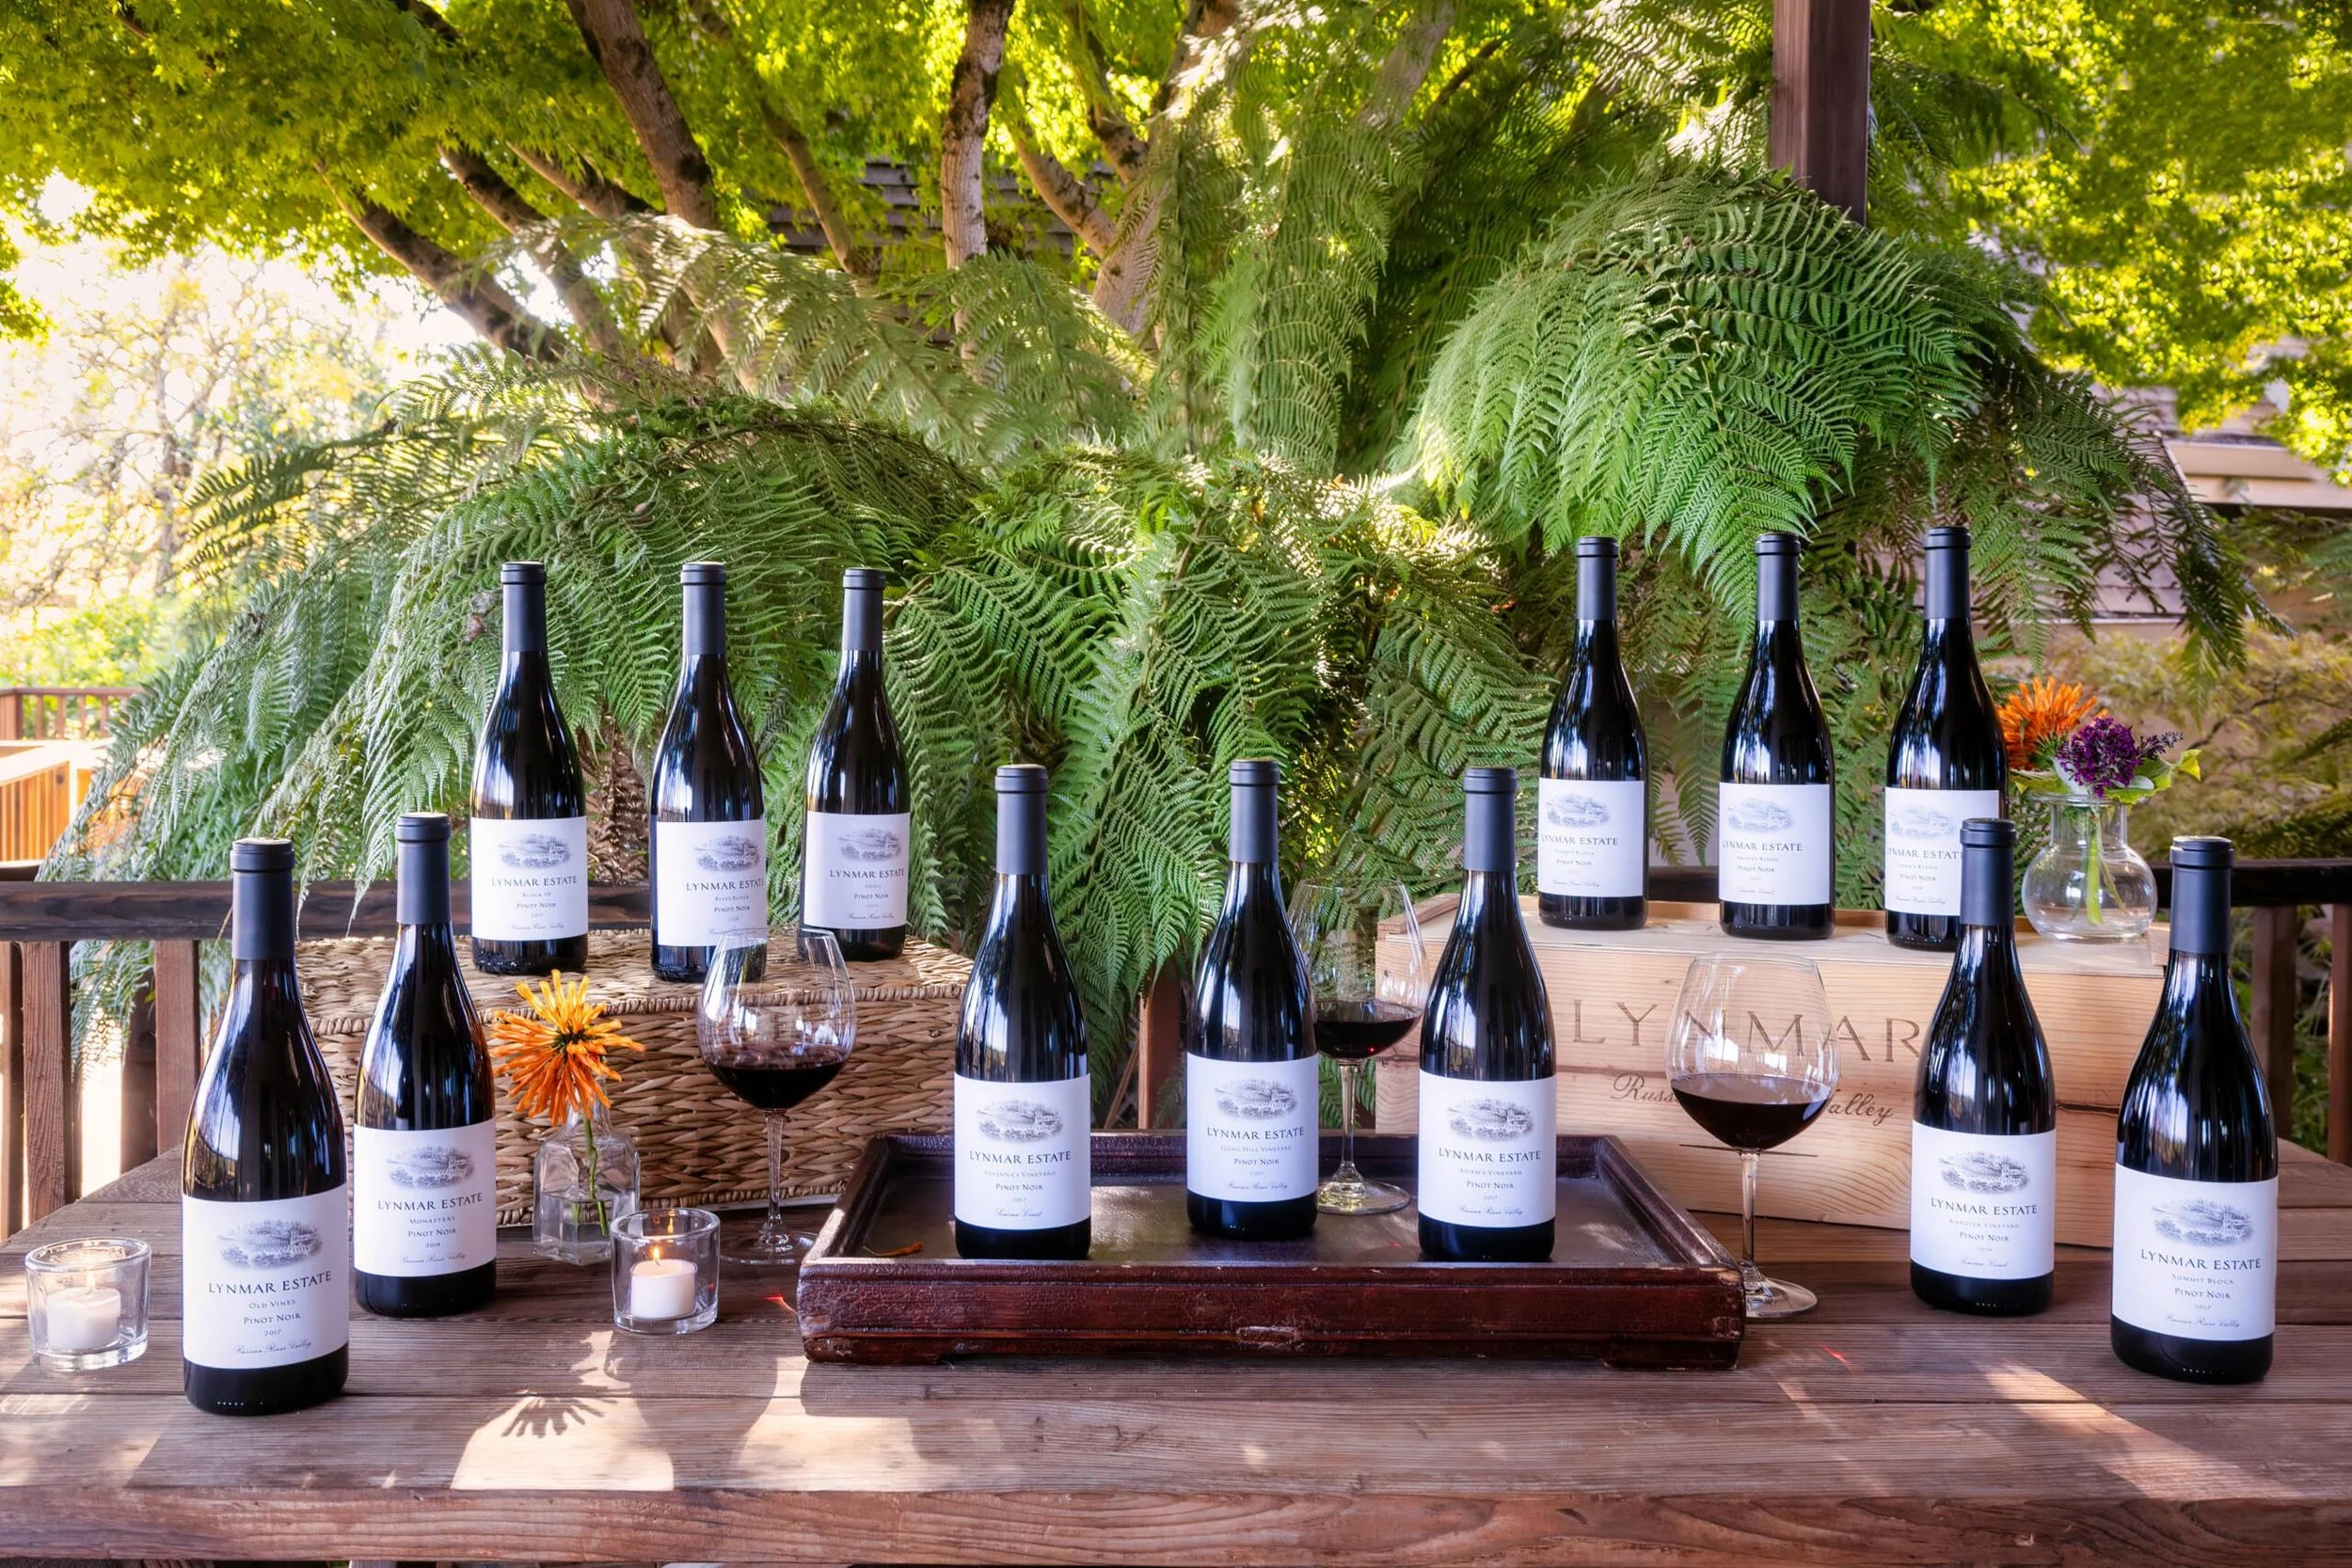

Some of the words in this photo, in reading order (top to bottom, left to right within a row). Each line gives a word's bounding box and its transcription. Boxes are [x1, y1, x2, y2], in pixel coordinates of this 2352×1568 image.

[1580, 837, 1618, 846] ESTATE
[1762, 843, 1803, 851] ESTATE
[830, 869, 876, 879] LYNMAR
[879, 868, 905, 879] ESTATE
[492, 878, 539, 887] LYNMAR
[544, 876, 577, 886] ESTATE
[687, 882, 736, 891] LYNMAR
[1573, 999, 1921, 1063] LYNMAR
[1611, 1072, 1678, 1103] Russ
[1829, 1088, 1895, 1127] alley
[1207, 1127, 1261, 1140] LYNMAR
[1265, 1126, 1305, 1140] ESTATE
[970, 1150, 1023, 1164] LYNMAR
[1027, 1150, 1072, 1164] ESTATE
[1438, 1147, 1494, 1163] LYNMAR
[1500, 1149, 1543, 1163] ESTATE
[1467, 1180, 1491, 1189] PINOT
[378, 1200, 437, 1211] LYNMAR
[441, 1192, 483, 1209] ESTATE
[1931, 1196, 1989, 1215] LYNMAR
[1994, 1205, 2038, 1216] ESTATE
[1960, 1231, 1985, 1241] PINOT
[2141, 1248, 2208, 1270] LYNMAR
[2214, 1259, 2262, 1271] ESTATE
[209, 1283, 276, 1294] LYNMAR
[282, 1271, 331, 1291] ESTATE
[2174, 1288, 2203, 1297] PINOT
[2207, 1291, 2232, 1299] NOIR
[270, 1299, 296, 1307] VINES
[277, 1312, 301, 1323] NOIR
